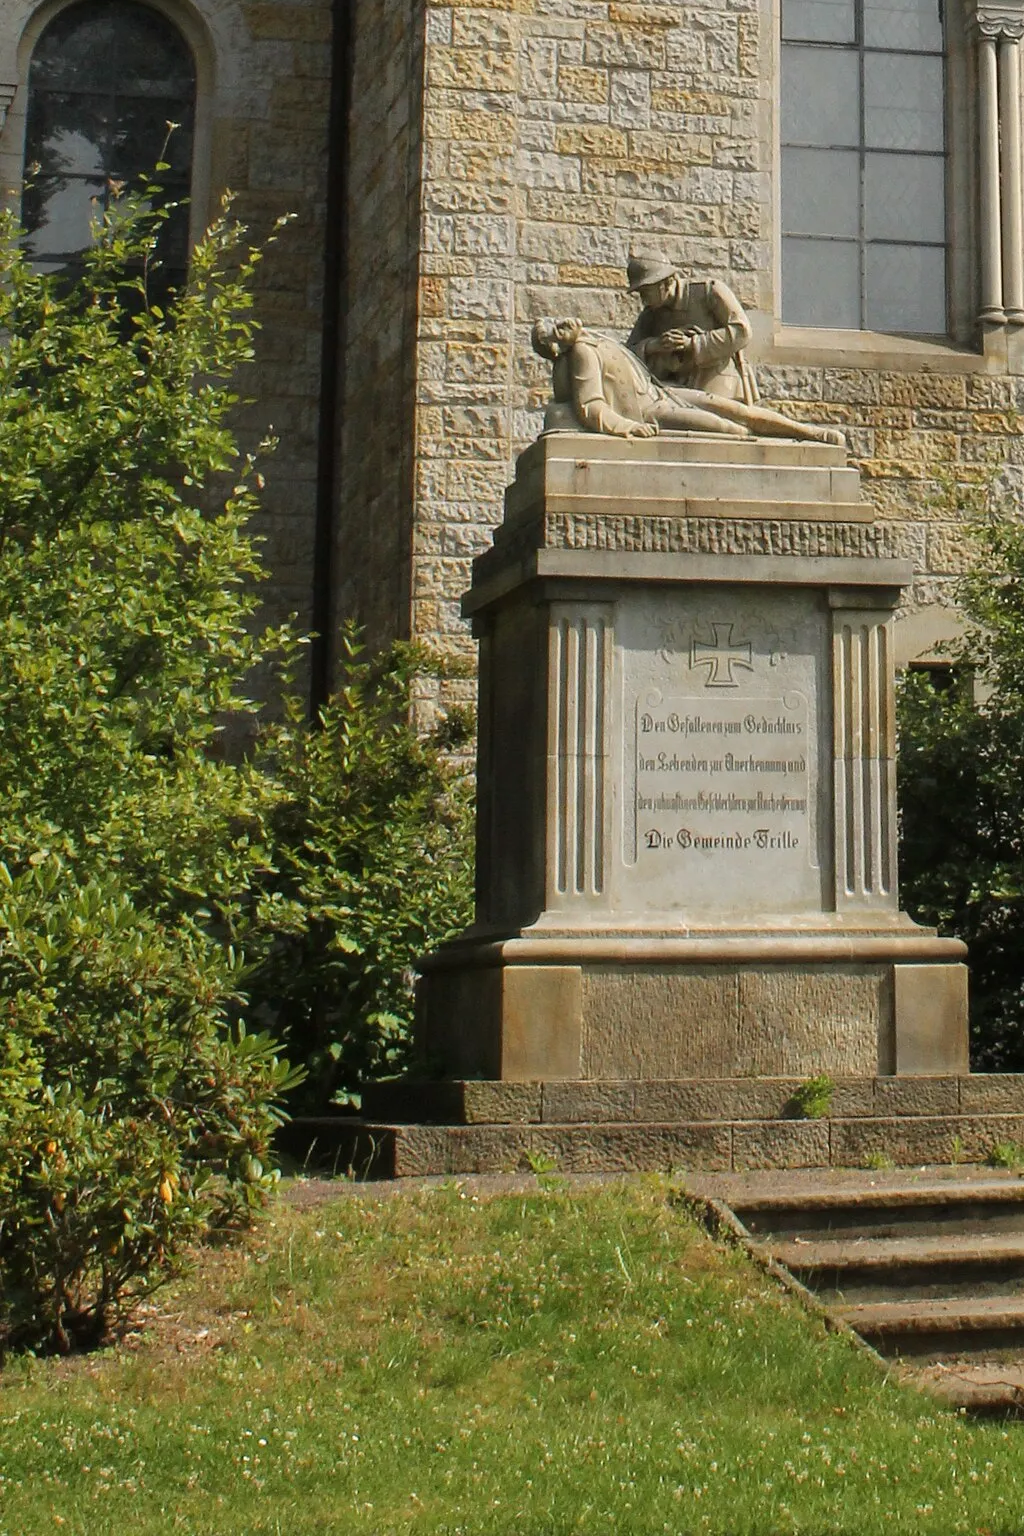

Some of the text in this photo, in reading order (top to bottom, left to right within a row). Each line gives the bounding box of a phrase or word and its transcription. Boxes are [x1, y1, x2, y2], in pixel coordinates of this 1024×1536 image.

[640, 712, 802, 739] Den Gefallenen zum Gedächtnis
[639, 751, 806, 778] den Lebenden zur Anerkennung und
[644, 828, 673, 849] Die
[677, 828, 751, 849] Gemeinde
